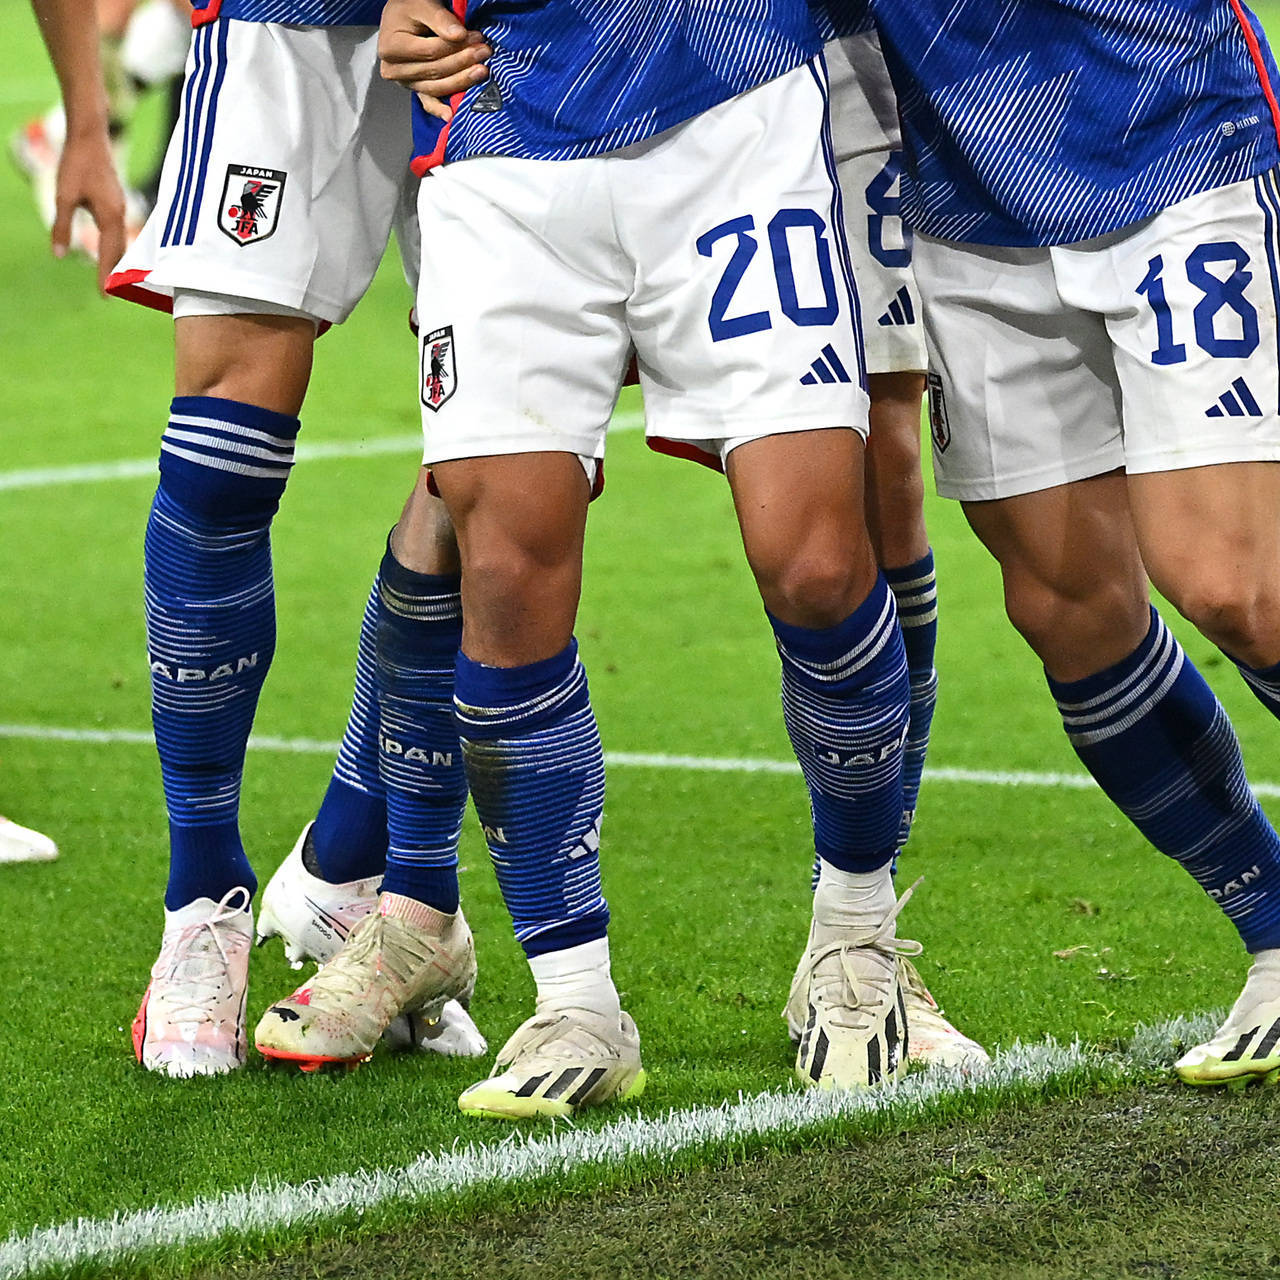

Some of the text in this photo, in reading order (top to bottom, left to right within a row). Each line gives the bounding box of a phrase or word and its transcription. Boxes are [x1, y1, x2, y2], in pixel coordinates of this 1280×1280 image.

[240, 167, 273, 178] JAPAN
[231, 220, 258, 235] JFA
[696, 208, 840, 342] 20
[1136, 241, 1260, 364] 18
[379, 733, 452, 767] PAN
[818, 720, 910, 767] JAP
[1206, 865, 1260, 898] PAN
